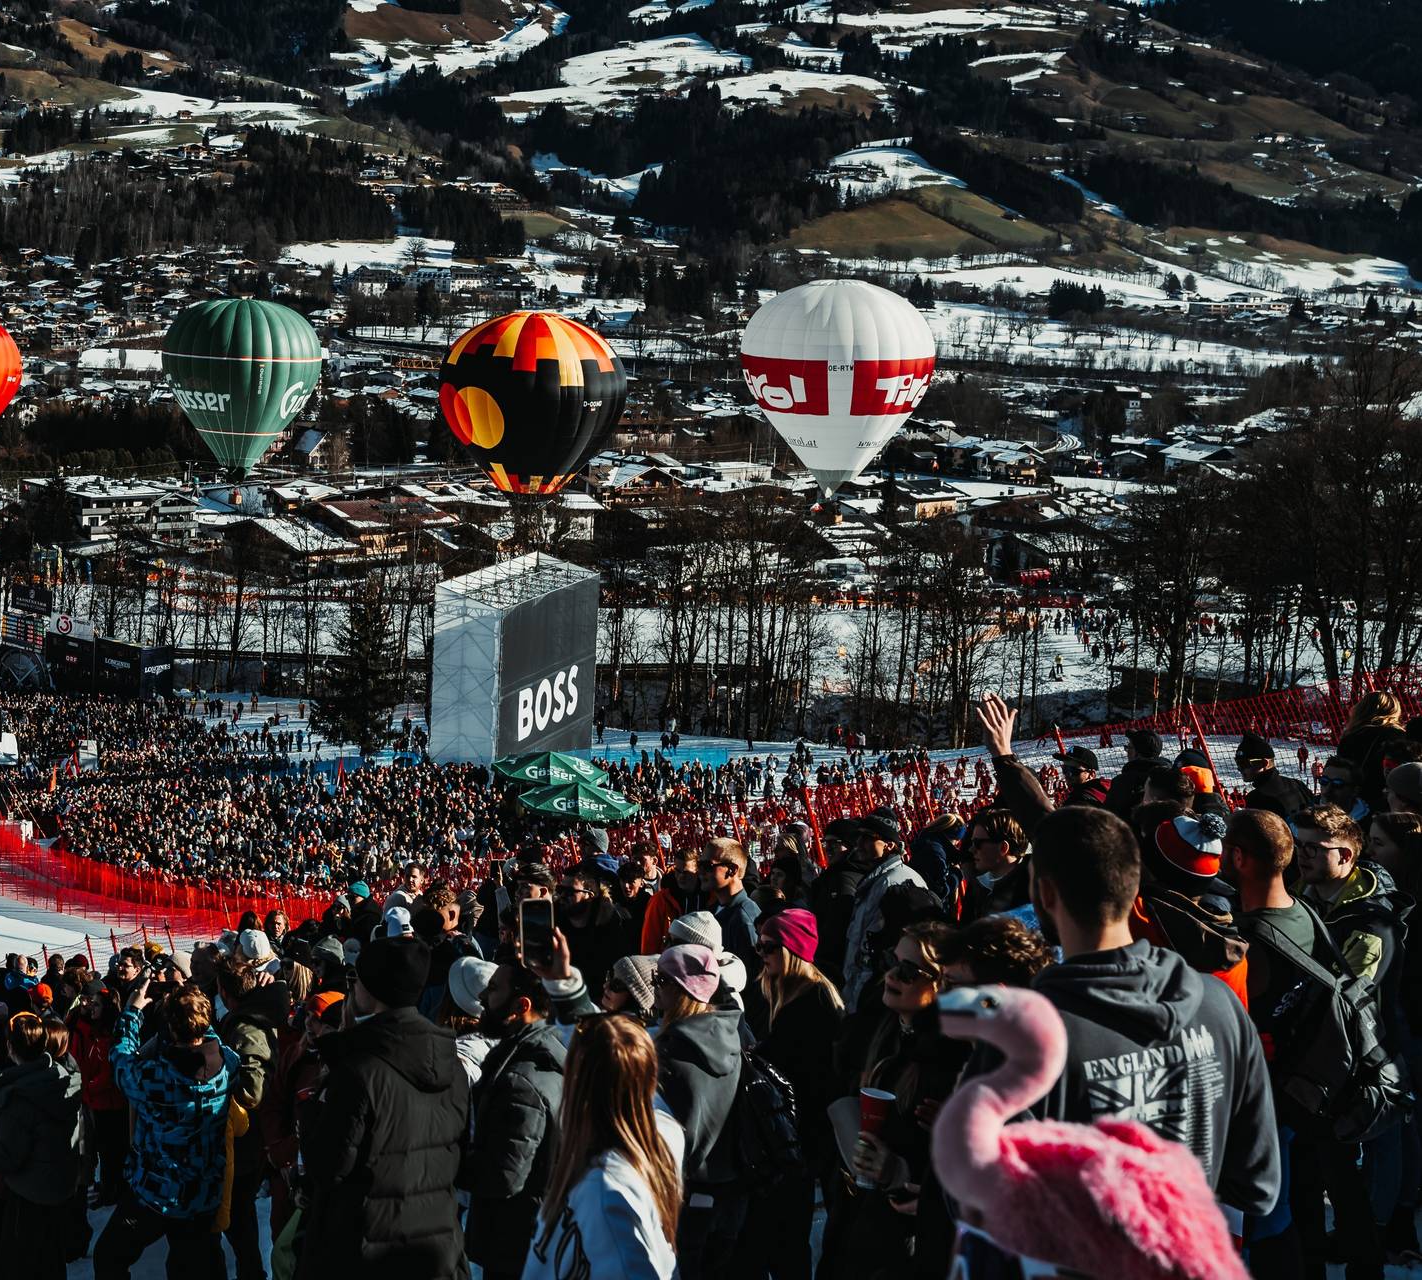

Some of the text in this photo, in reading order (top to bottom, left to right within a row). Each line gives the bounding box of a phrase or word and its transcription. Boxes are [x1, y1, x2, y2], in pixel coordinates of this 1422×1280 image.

[742, 368, 807, 409] irol
[144, 663, 171, 674] LONGINES
[518, 664, 579, 742] BOSS
[525, 765, 576, 782] Gösser
[553, 797, 607, 812] Gösser
[1083, 1044, 1184, 1080] ENGLAND
